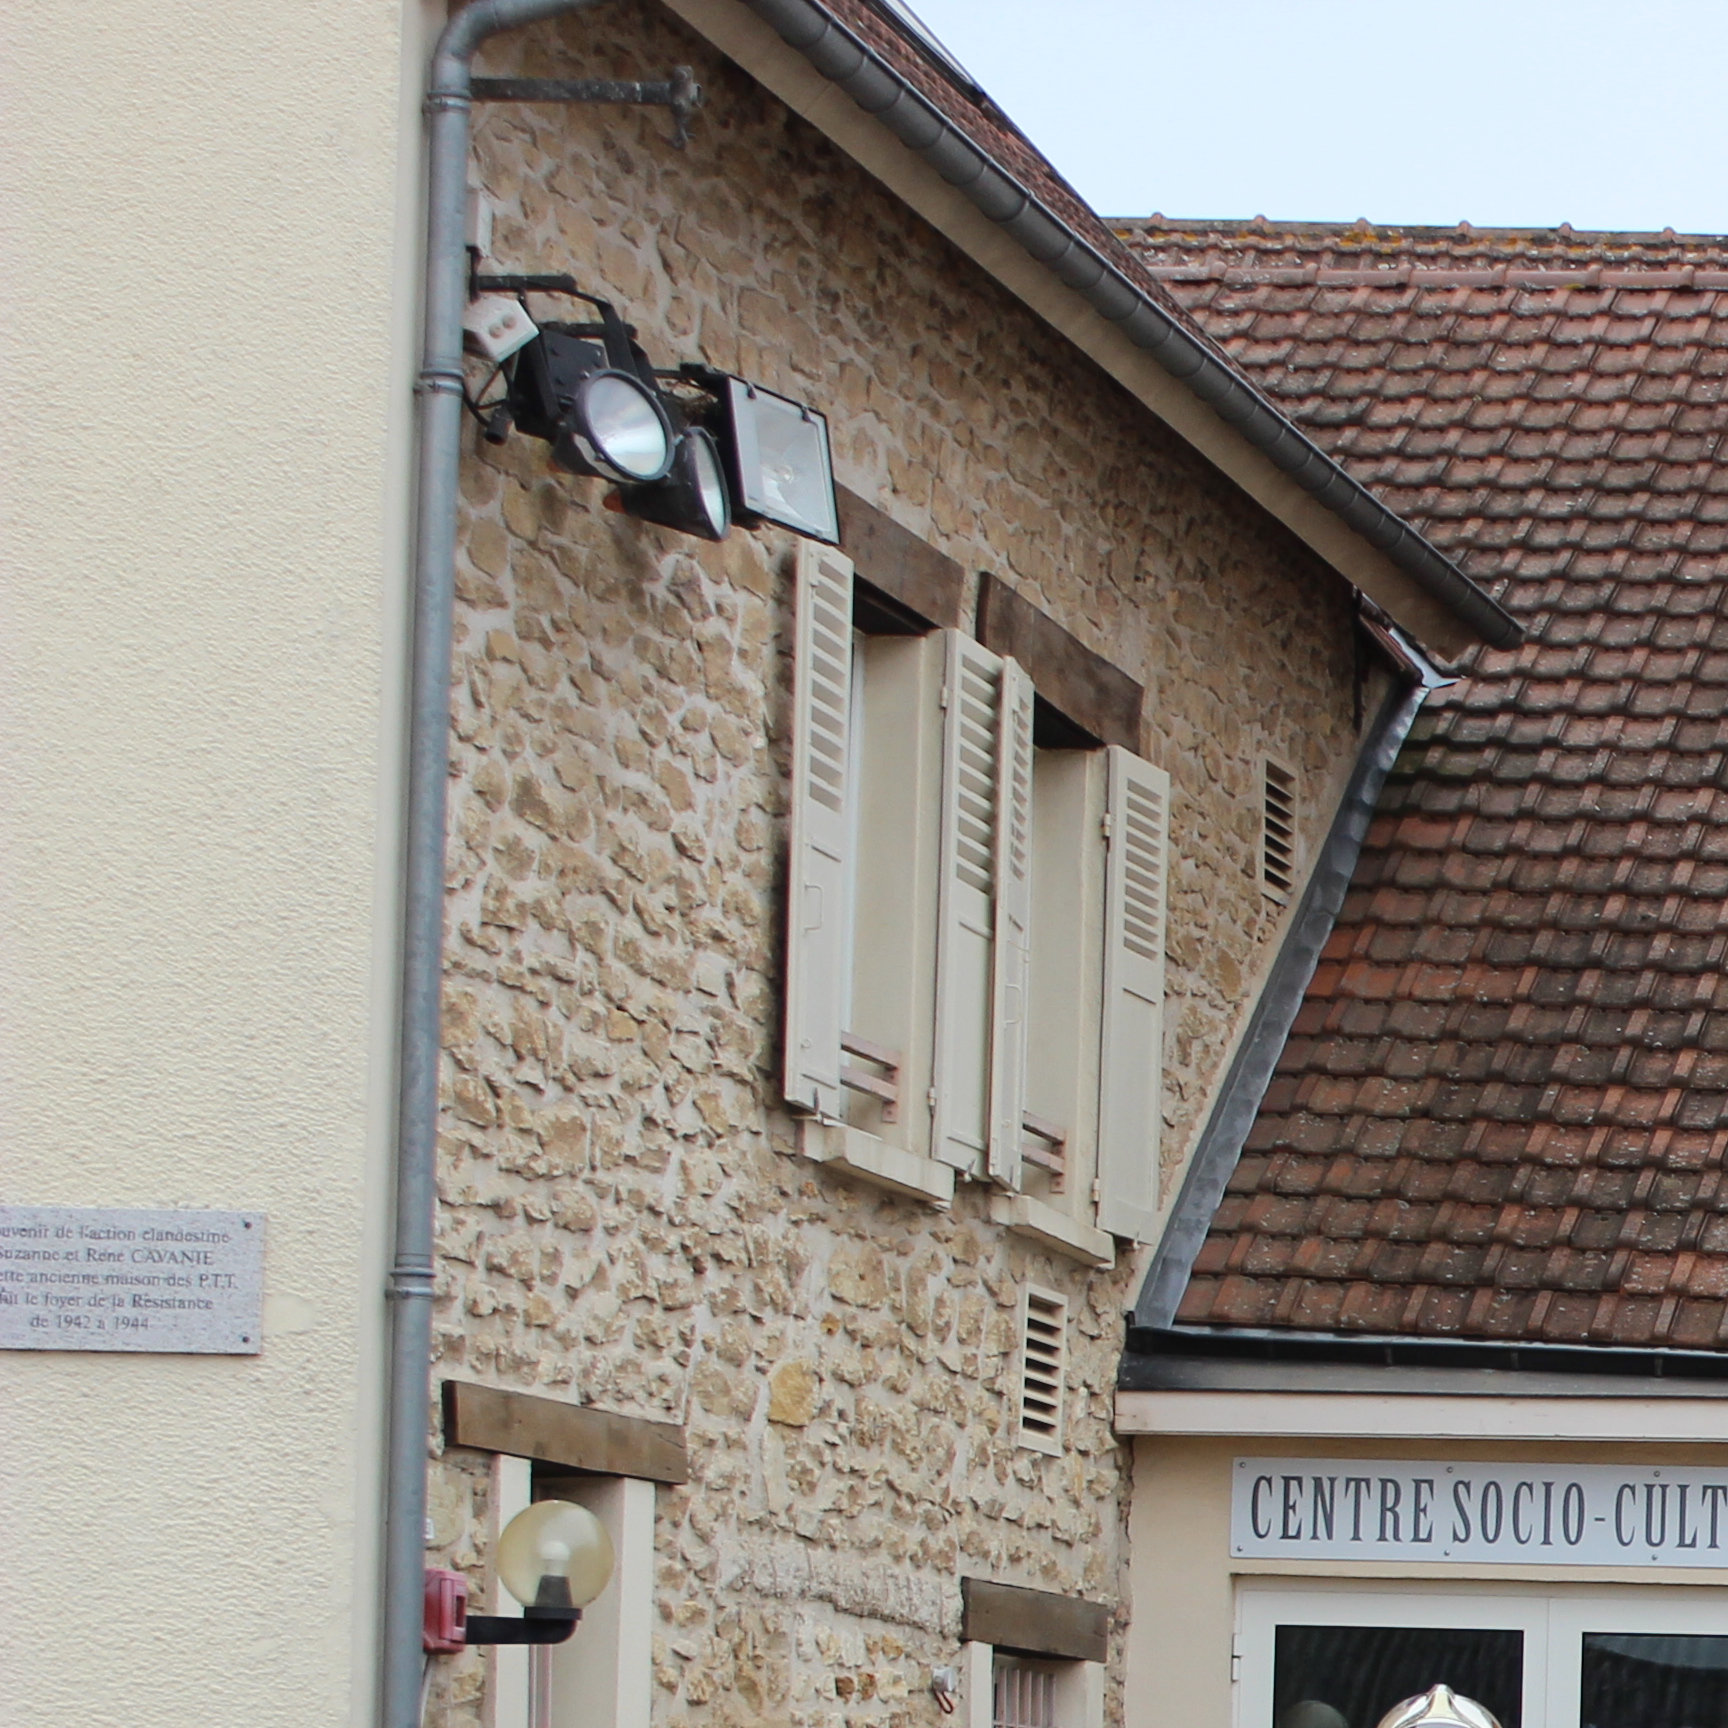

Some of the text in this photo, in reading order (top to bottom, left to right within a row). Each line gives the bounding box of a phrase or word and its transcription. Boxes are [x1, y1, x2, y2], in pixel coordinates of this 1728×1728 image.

[0, 1226, 49, 1239] uvenir
[55, 1225, 74, 1239] de
[65, 1250, 80, 1262] et
[131, 1248, 215, 1266] CAVANIE
[30, 1272, 100, 1285] ancienne
[105, 1273, 160, 1286] maison
[167, 1273, 192, 1287] des
[25, 1292, 38, 1306] le
[44, 1292, 83, 1309] foyer
[87, 1293, 106, 1307] de
[112, 1294, 125, 1308] la
[30, 1315, 49, 1328] de
[56, 1314, 91, 1329] 1942
[114, 1316, 148, 1331] 1944
[1250, 1474, 1436, 1545] CENTRE
